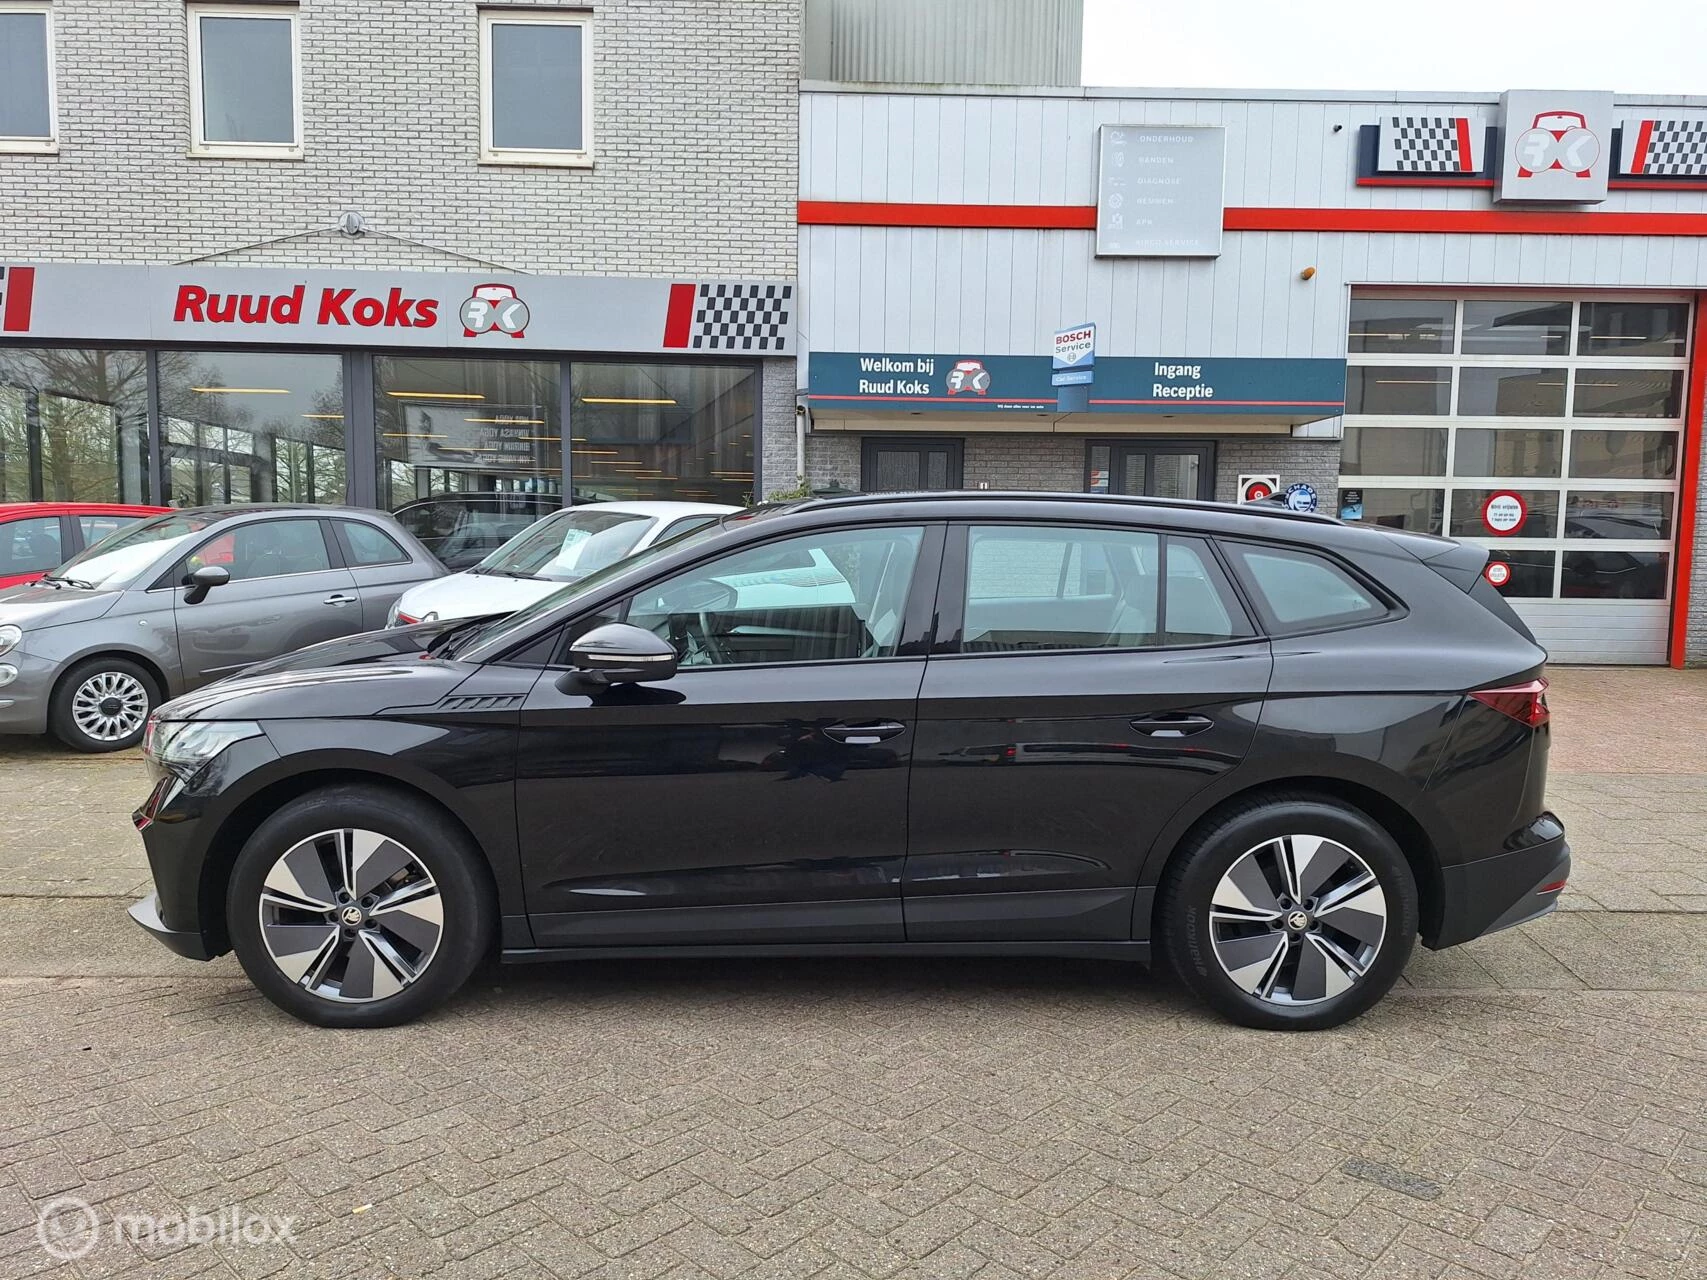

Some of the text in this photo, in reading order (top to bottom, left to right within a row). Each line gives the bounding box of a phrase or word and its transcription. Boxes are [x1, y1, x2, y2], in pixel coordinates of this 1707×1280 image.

[1139, 135, 1195, 143] ONDERHOUD
[173, 284, 439, 329] Ruud Koks
[1055, 329, 1092, 345] BOSCH
[1055, 341, 1092, 354] Service
[860, 357, 935, 377] Welkom bij
[1154, 361, 1202, 379] Ingang
[859, 379, 930, 395] Ruud Koks
[1152, 383, 1214, 401] Receptie
